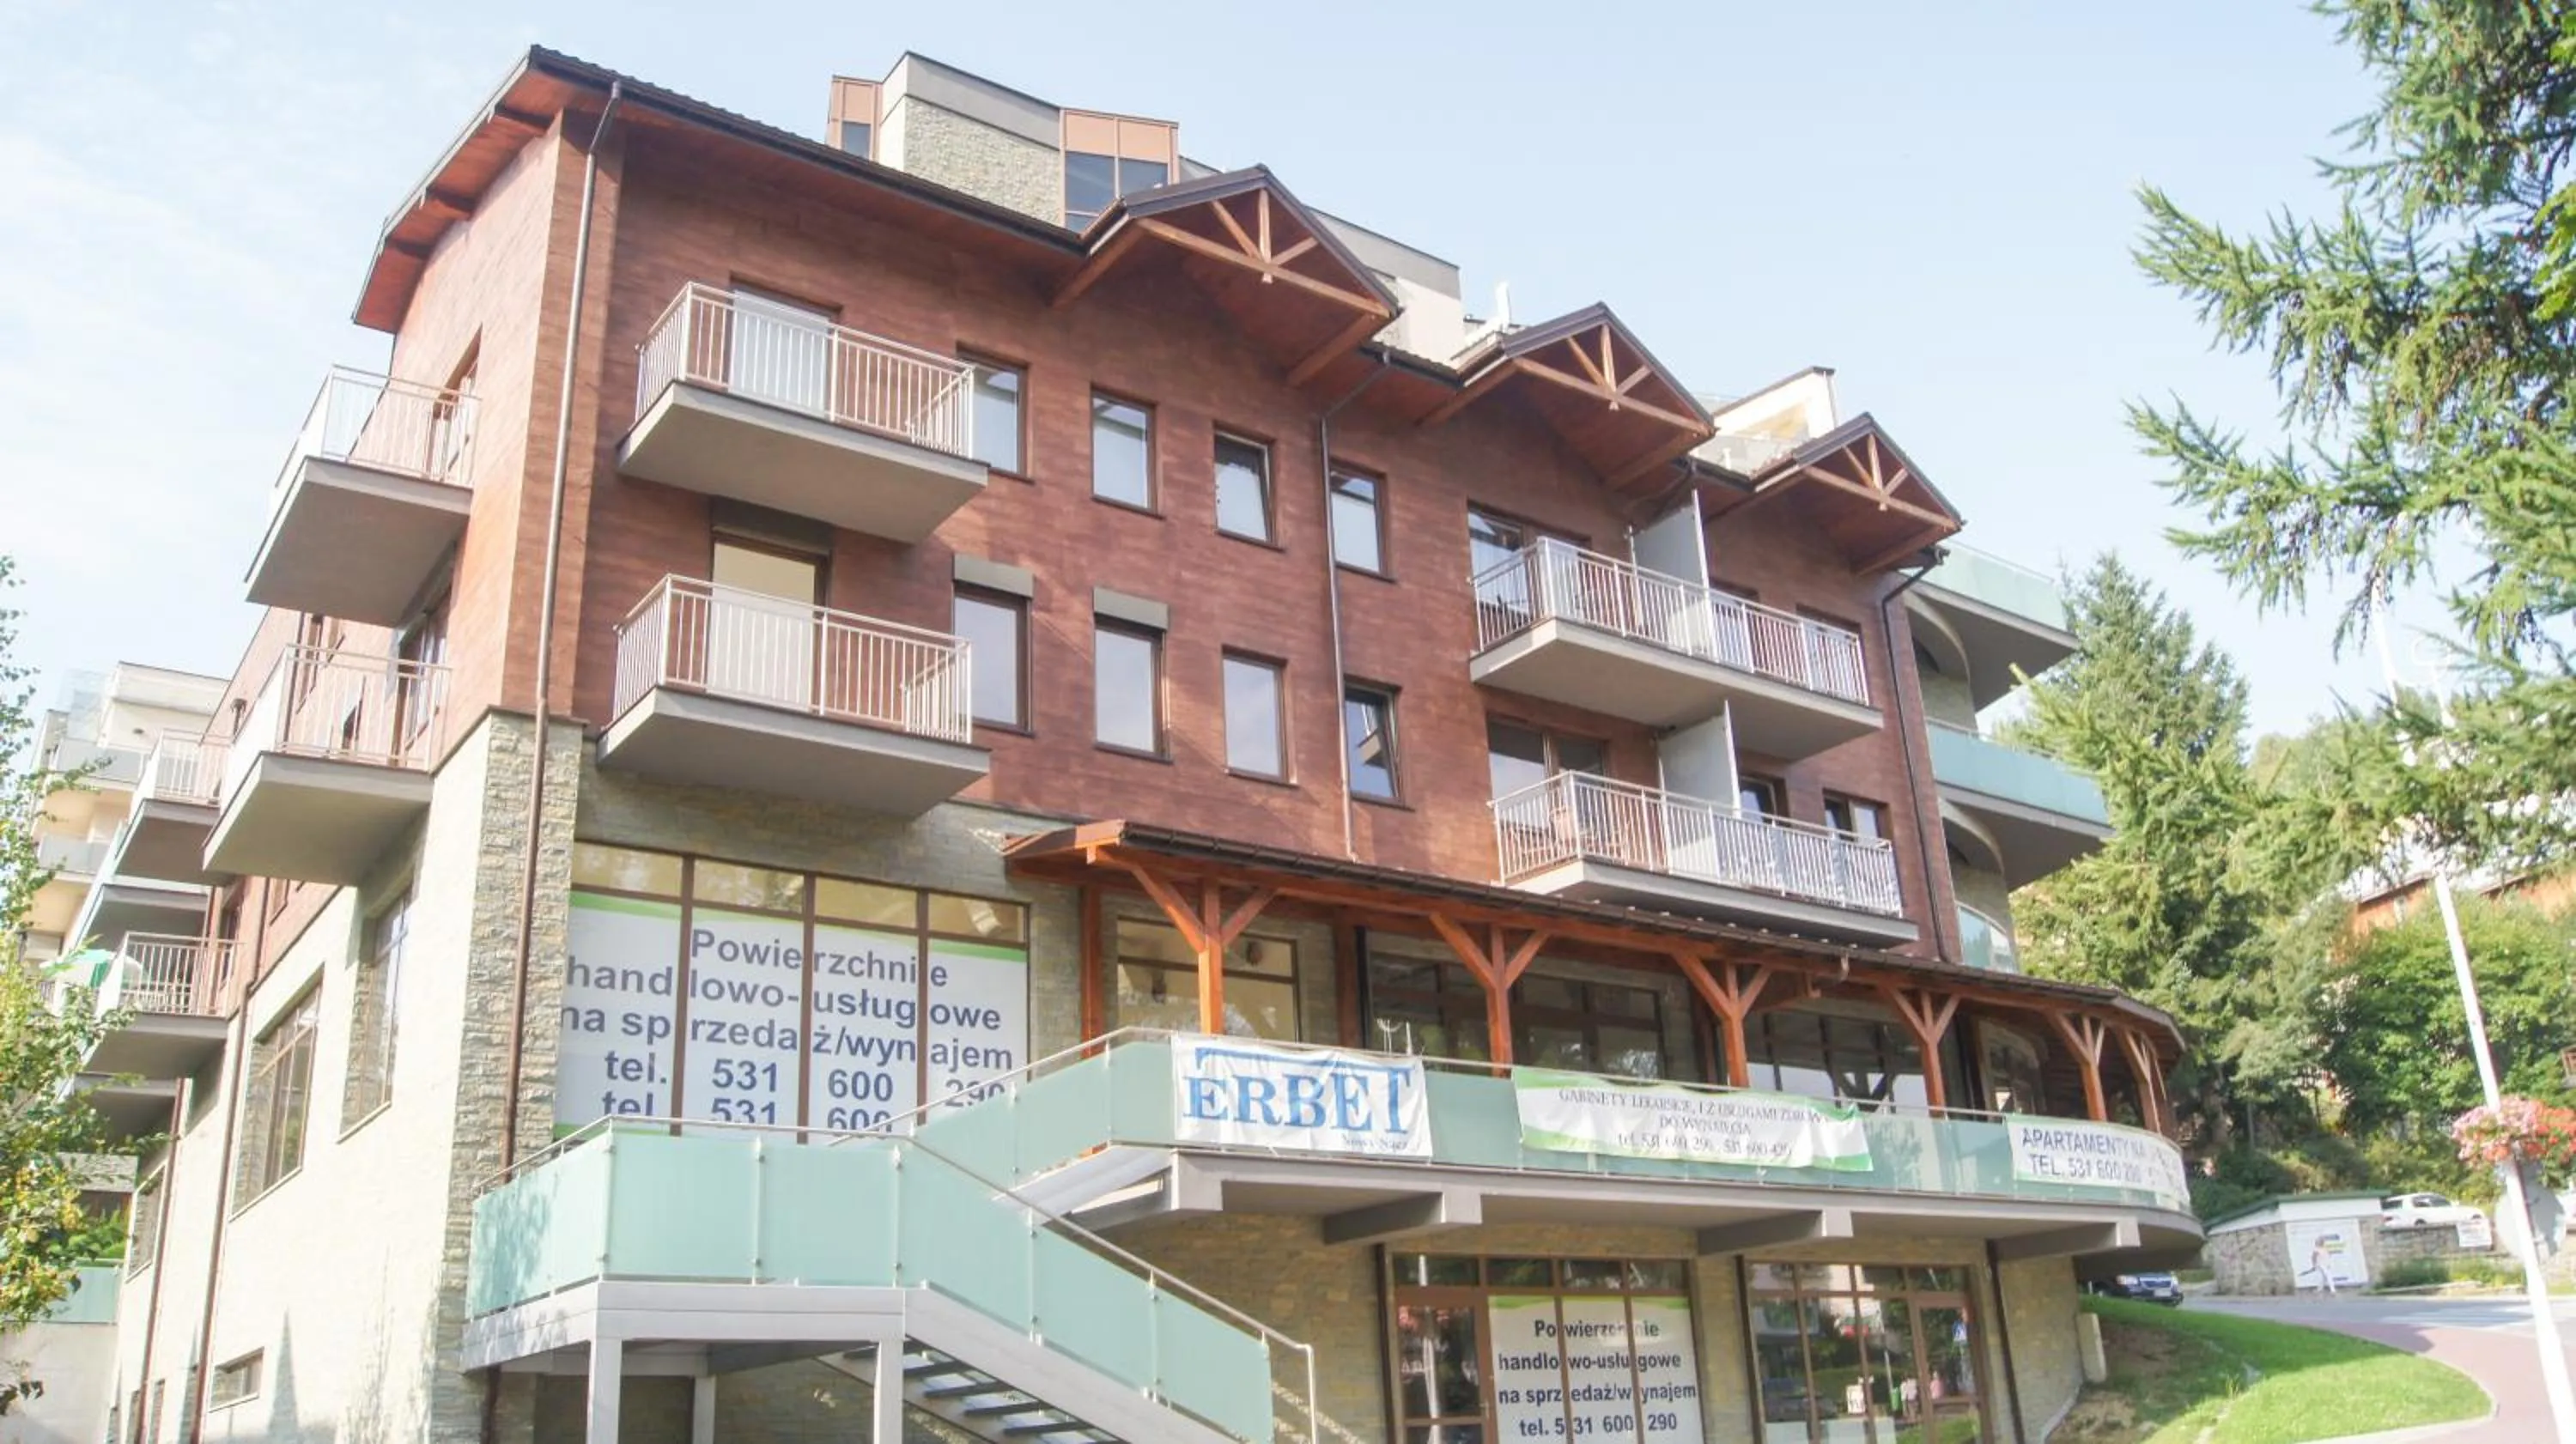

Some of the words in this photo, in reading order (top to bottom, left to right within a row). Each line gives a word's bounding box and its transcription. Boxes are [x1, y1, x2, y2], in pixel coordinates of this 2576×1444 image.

[692, 930, 948, 986] Powierzchnie
[561, 1004, 605, 1033] na
[605, 1051, 667, 1084] tel.
[712, 1059, 777, 1092] 531
[829, 1070, 893, 1101] 600
[1183, 1047, 1413, 1134] ERBET
[1559, 1089, 1626, 1107] GABINETY
[2023, 1128, 2128, 1157] APARTAMENTY
[2030, 1153, 2064, 1175] TEL.
[2069, 1157, 2091, 1178] 531
[1498, 1389, 1519, 1405] na
[1519, 1418, 1548, 1436] tel.
[1555, 1417, 1592, 1435] 531
[1603, 1414, 1633, 1432] 600
[1648, 1413, 1678, 1431] 290
